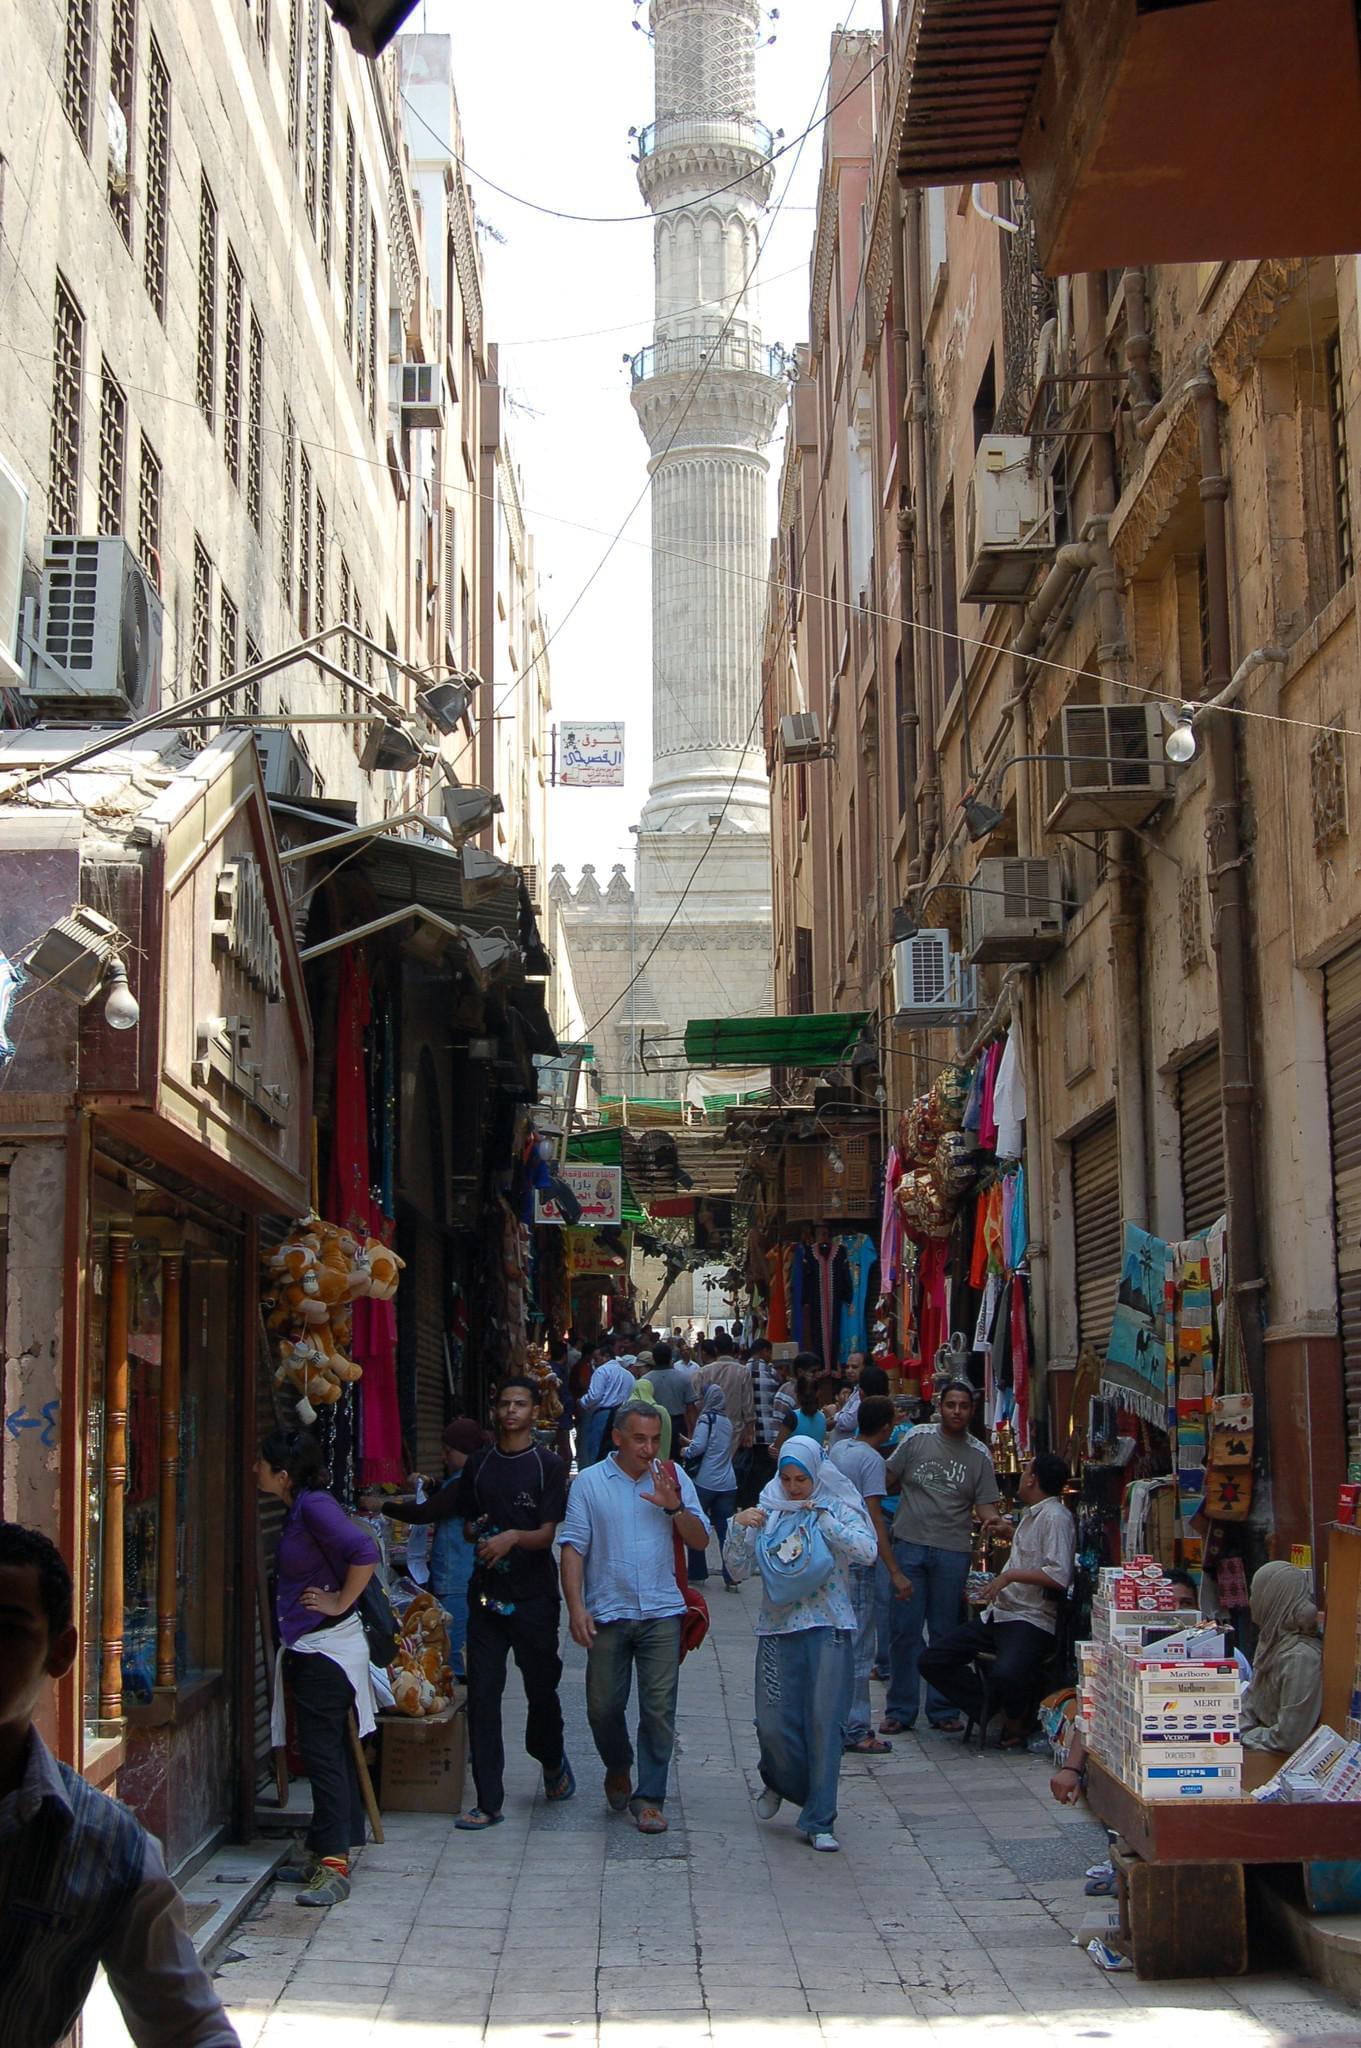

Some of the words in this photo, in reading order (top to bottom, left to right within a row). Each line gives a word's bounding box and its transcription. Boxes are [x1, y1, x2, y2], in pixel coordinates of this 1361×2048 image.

[1178, 1682, 1206, 1693] Marlboro
[1193, 1699, 1222, 1707] MERIT
[1164, 1751, 1196, 1759] DORCHESTER
